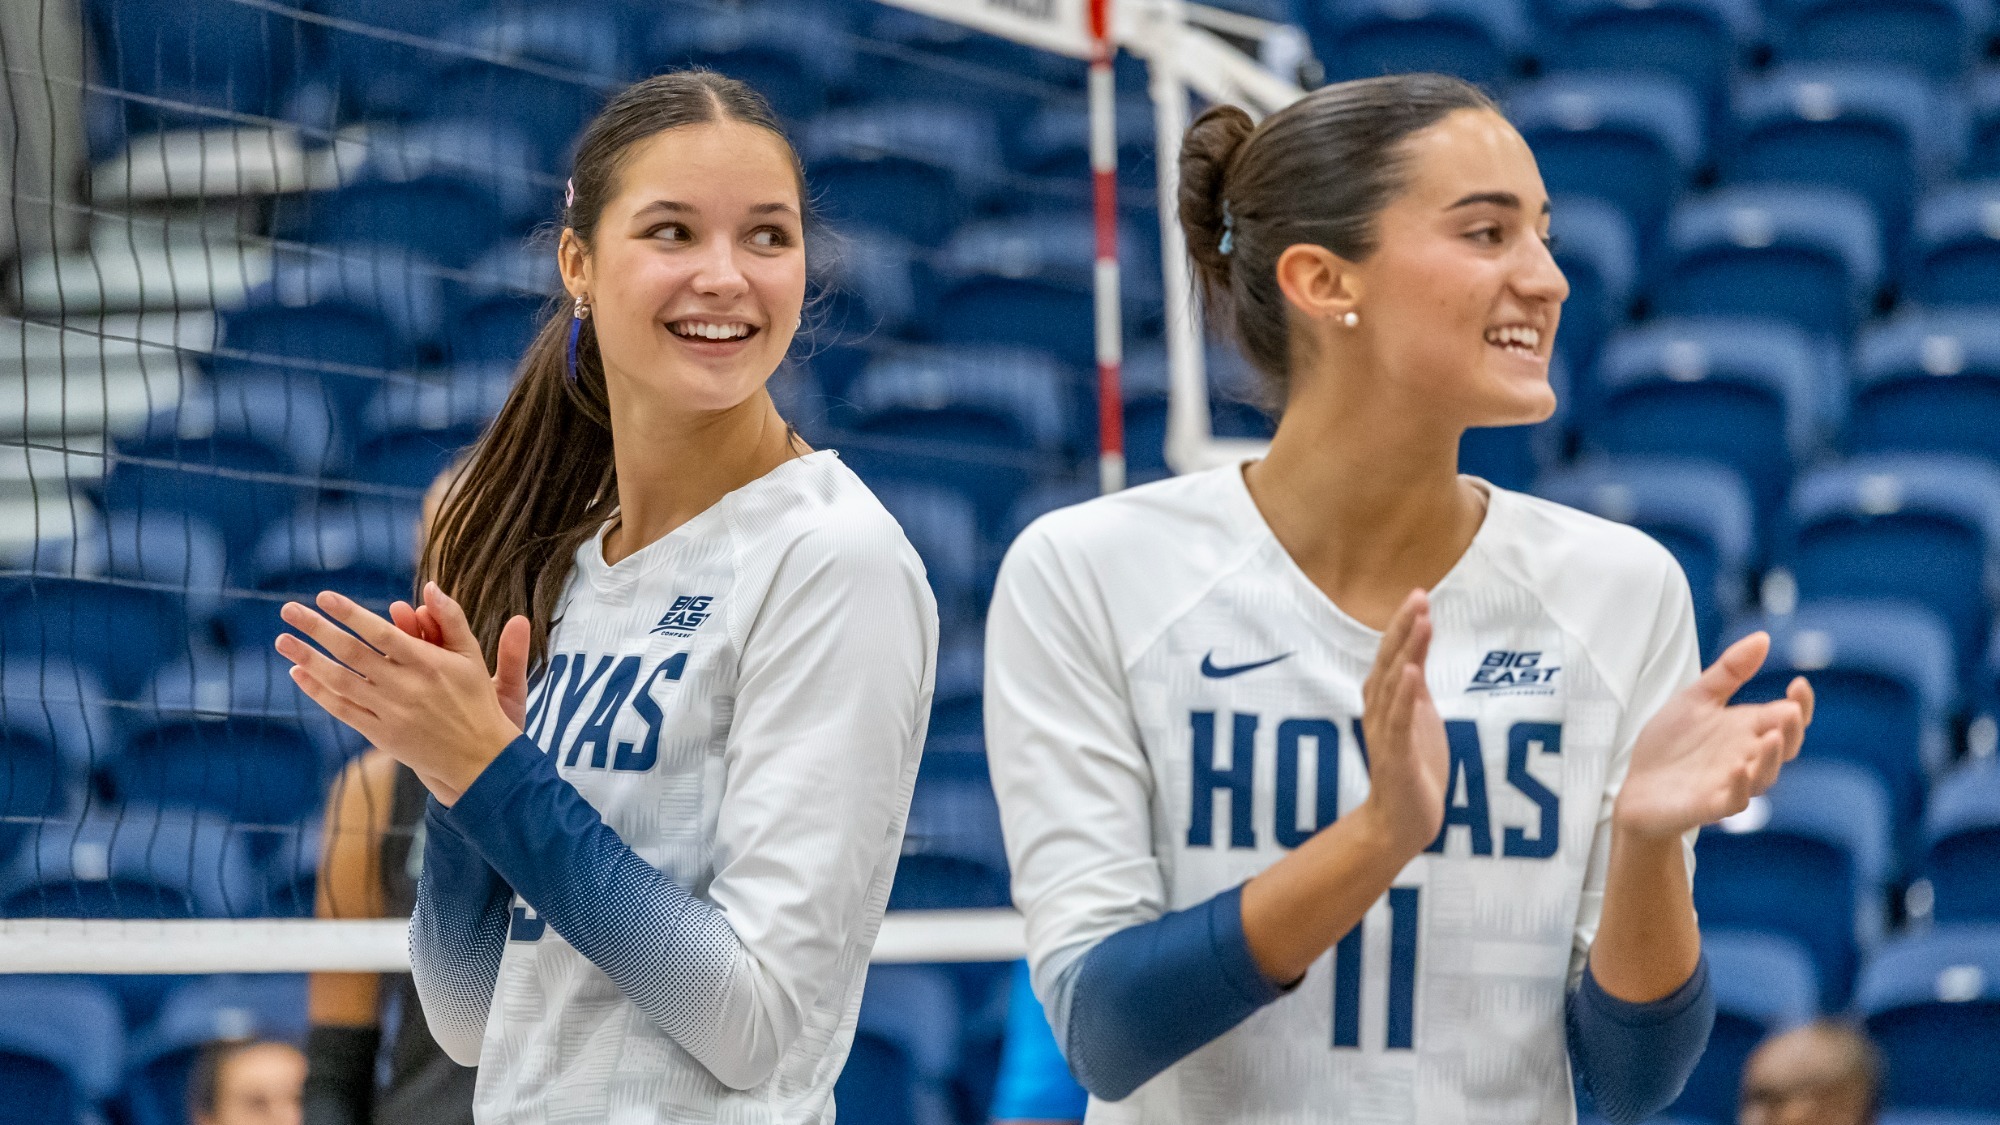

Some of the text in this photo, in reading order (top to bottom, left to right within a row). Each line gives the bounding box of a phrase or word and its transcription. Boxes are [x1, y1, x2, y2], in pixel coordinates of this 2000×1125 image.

[669, 595, 714, 611] BIG
[1481, 650, 1543, 667] BIG
[1471, 667, 1561, 684] EAST
[1187, 710, 1562, 858] HOAS
[1333, 885, 1420, 1048] 11
